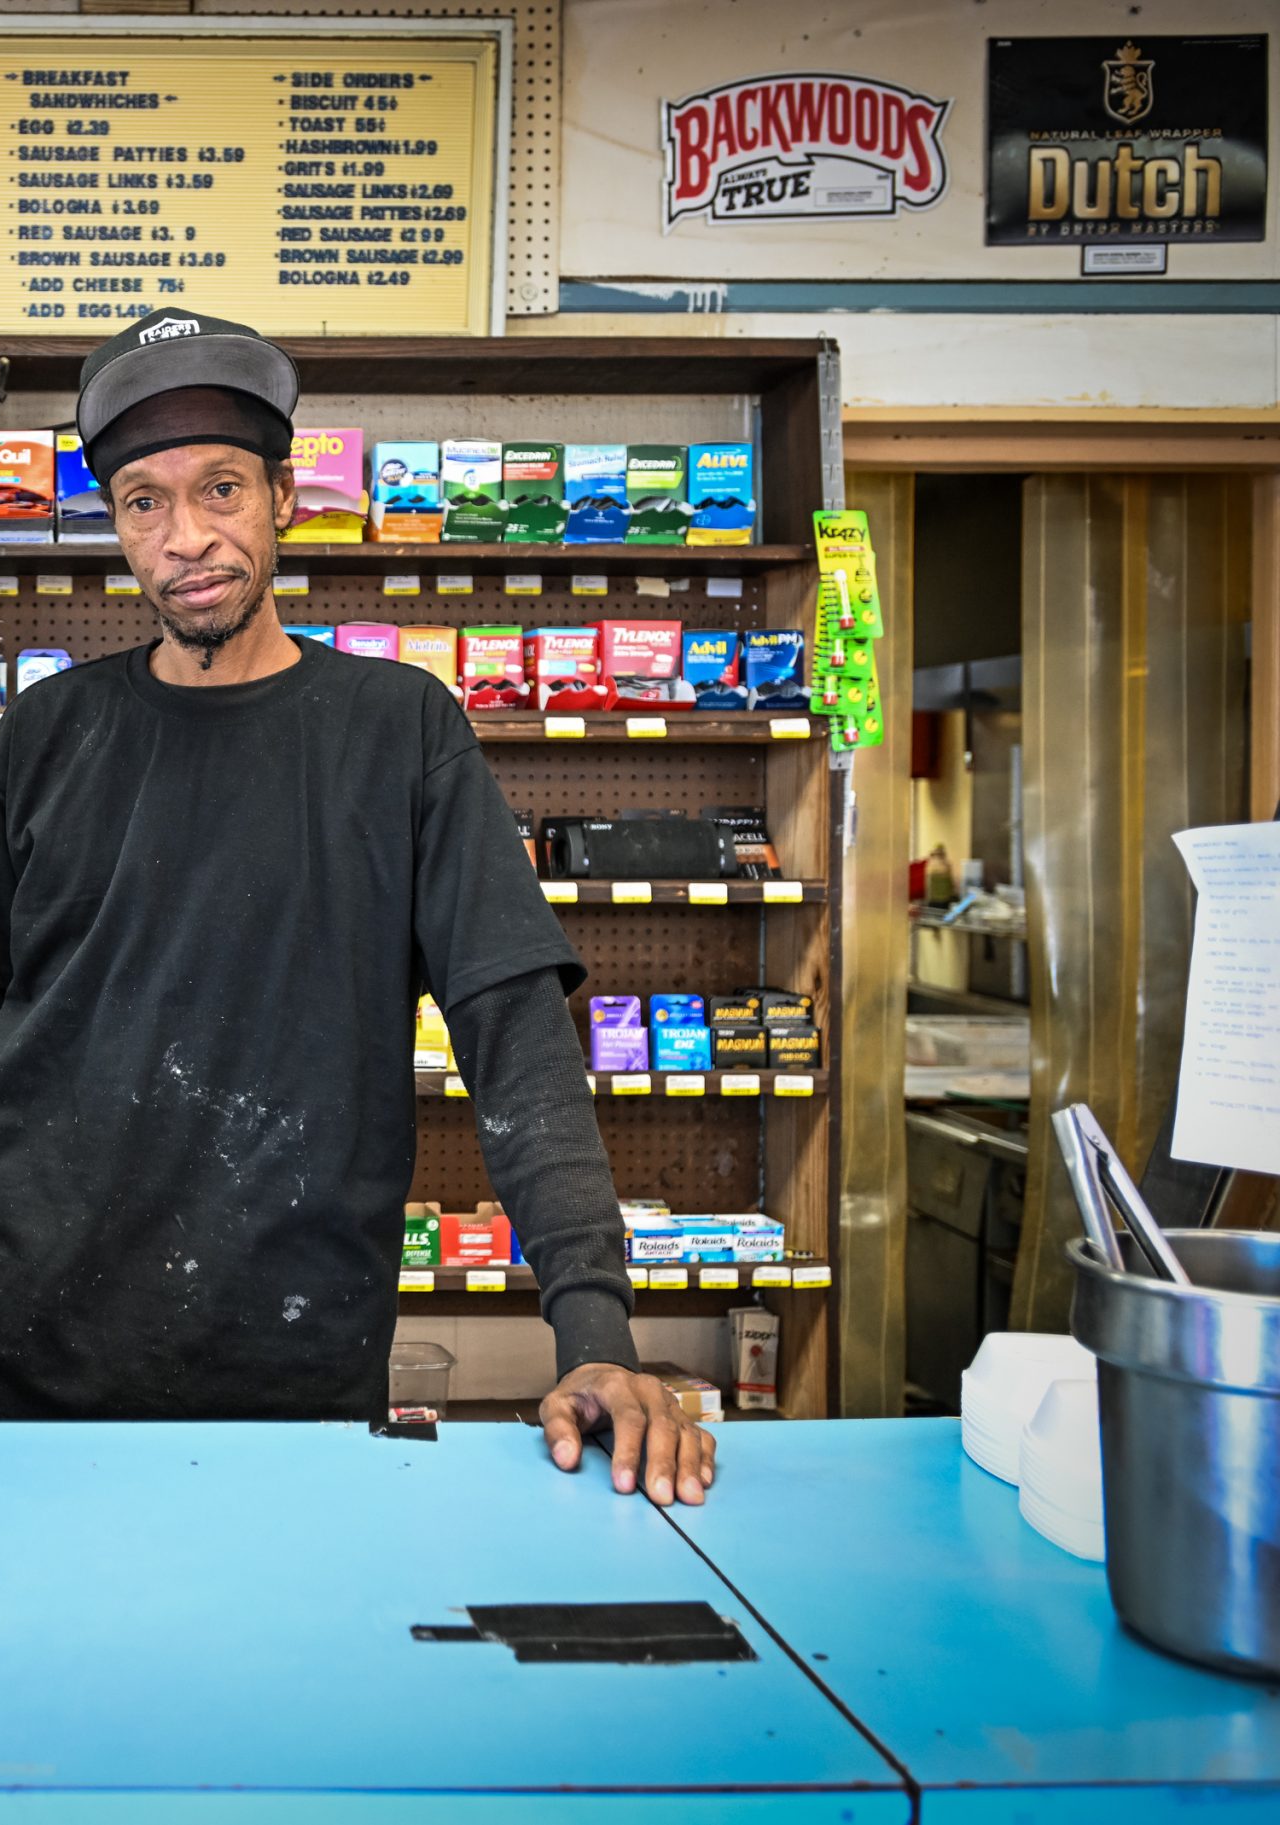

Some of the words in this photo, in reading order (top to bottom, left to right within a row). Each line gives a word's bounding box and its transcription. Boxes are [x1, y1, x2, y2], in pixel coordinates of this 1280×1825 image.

[23, 71, 129, 86] BREAKFAST
[292, 72, 333, 88] SIDE
[343, 73, 414, 88] ORDERS
[30, 93, 159, 109] SANDWHICHES
[291, 95, 358, 110] BISCUIT
[19, 119, 54, 134] EGG
[290, 117, 345, 132] TOAST
[675, 81, 936, 201] BACKWOODS
[1030, 131, 1097, 141] NATURAL
[1106, 130, 1143, 140] LEAF
[1149, 129, 1223, 139] WRAPPER
[19, 146, 99, 161] SAUSAGE
[114, 147, 187, 162] PATTIES
[286, 140, 391, 154] HASHBROWN
[284, 161, 335, 176] GRITS
[19, 173, 98, 188] SAUSAGE
[108, 174, 157, 188] LINKS
[723, 168, 767, 185] ALWAYS
[1028, 143, 1221, 220] Dutch
[284, 183, 355, 198] SAUSAGE
[362, 184, 408, 199] LINKS
[722, 170, 811, 212] TRUE
[19, 199, 101, 214] BOLOGNA
[282, 206, 353, 220] SAUSAGE
[361, 206, 422, 220] PATTIES
[19, 225, 52, 240] RED
[63, 226, 141, 240] SAUSAGE
[281, 227, 312, 241] RED
[320, 228, 392, 242] SAUSAGE
[1027, 224, 1050, 236] BY
[1131, 221, 1218, 234] MASTERS
[19, 252, 80, 266] BROWN
[90, 252, 170, 266] SAUSAGE
[280, 249, 339, 263] BROWN
[347, 249, 418, 264] SAUSAGE
[29, 278, 63, 291] ADD
[73, 278, 142, 292] CHEESE
[279, 271, 359, 284] BOLOGNA
[29, 304, 64, 317] ADD
[79, 304, 111, 317] EGG
[290, 432, 345, 456] epto
[696, 452, 748, 468] ALEVE
[544, 636, 594, 649] TYLENOL
[612, 627, 672, 643] TYLENOL
[750, 635, 778, 646] Advil
[467, 637, 520, 651] TYLENOL
[688, 640, 727, 655] Advil
[591, 823, 613, 831] SONY
[733, 833, 767, 842] ACELL
[715, 1007, 754, 1018] MAGNUM
[767, 1006, 807, 1017] MAGNUM
[600, 1028, 645, 1039] TROJAN
[661, 1028, 706, 1039] TROJAN
[673, 1039, 695, 1050] ENZ
[716, 1038, 765, 1052] MAGNUM
[770, 1037, 819, 1051] MAGNUM
[639, 1241, 680, 1252] Rolaids
[691, 1236, 727, 1246] Rolaids
[737, 1237, 780, 1248] Rolaids
